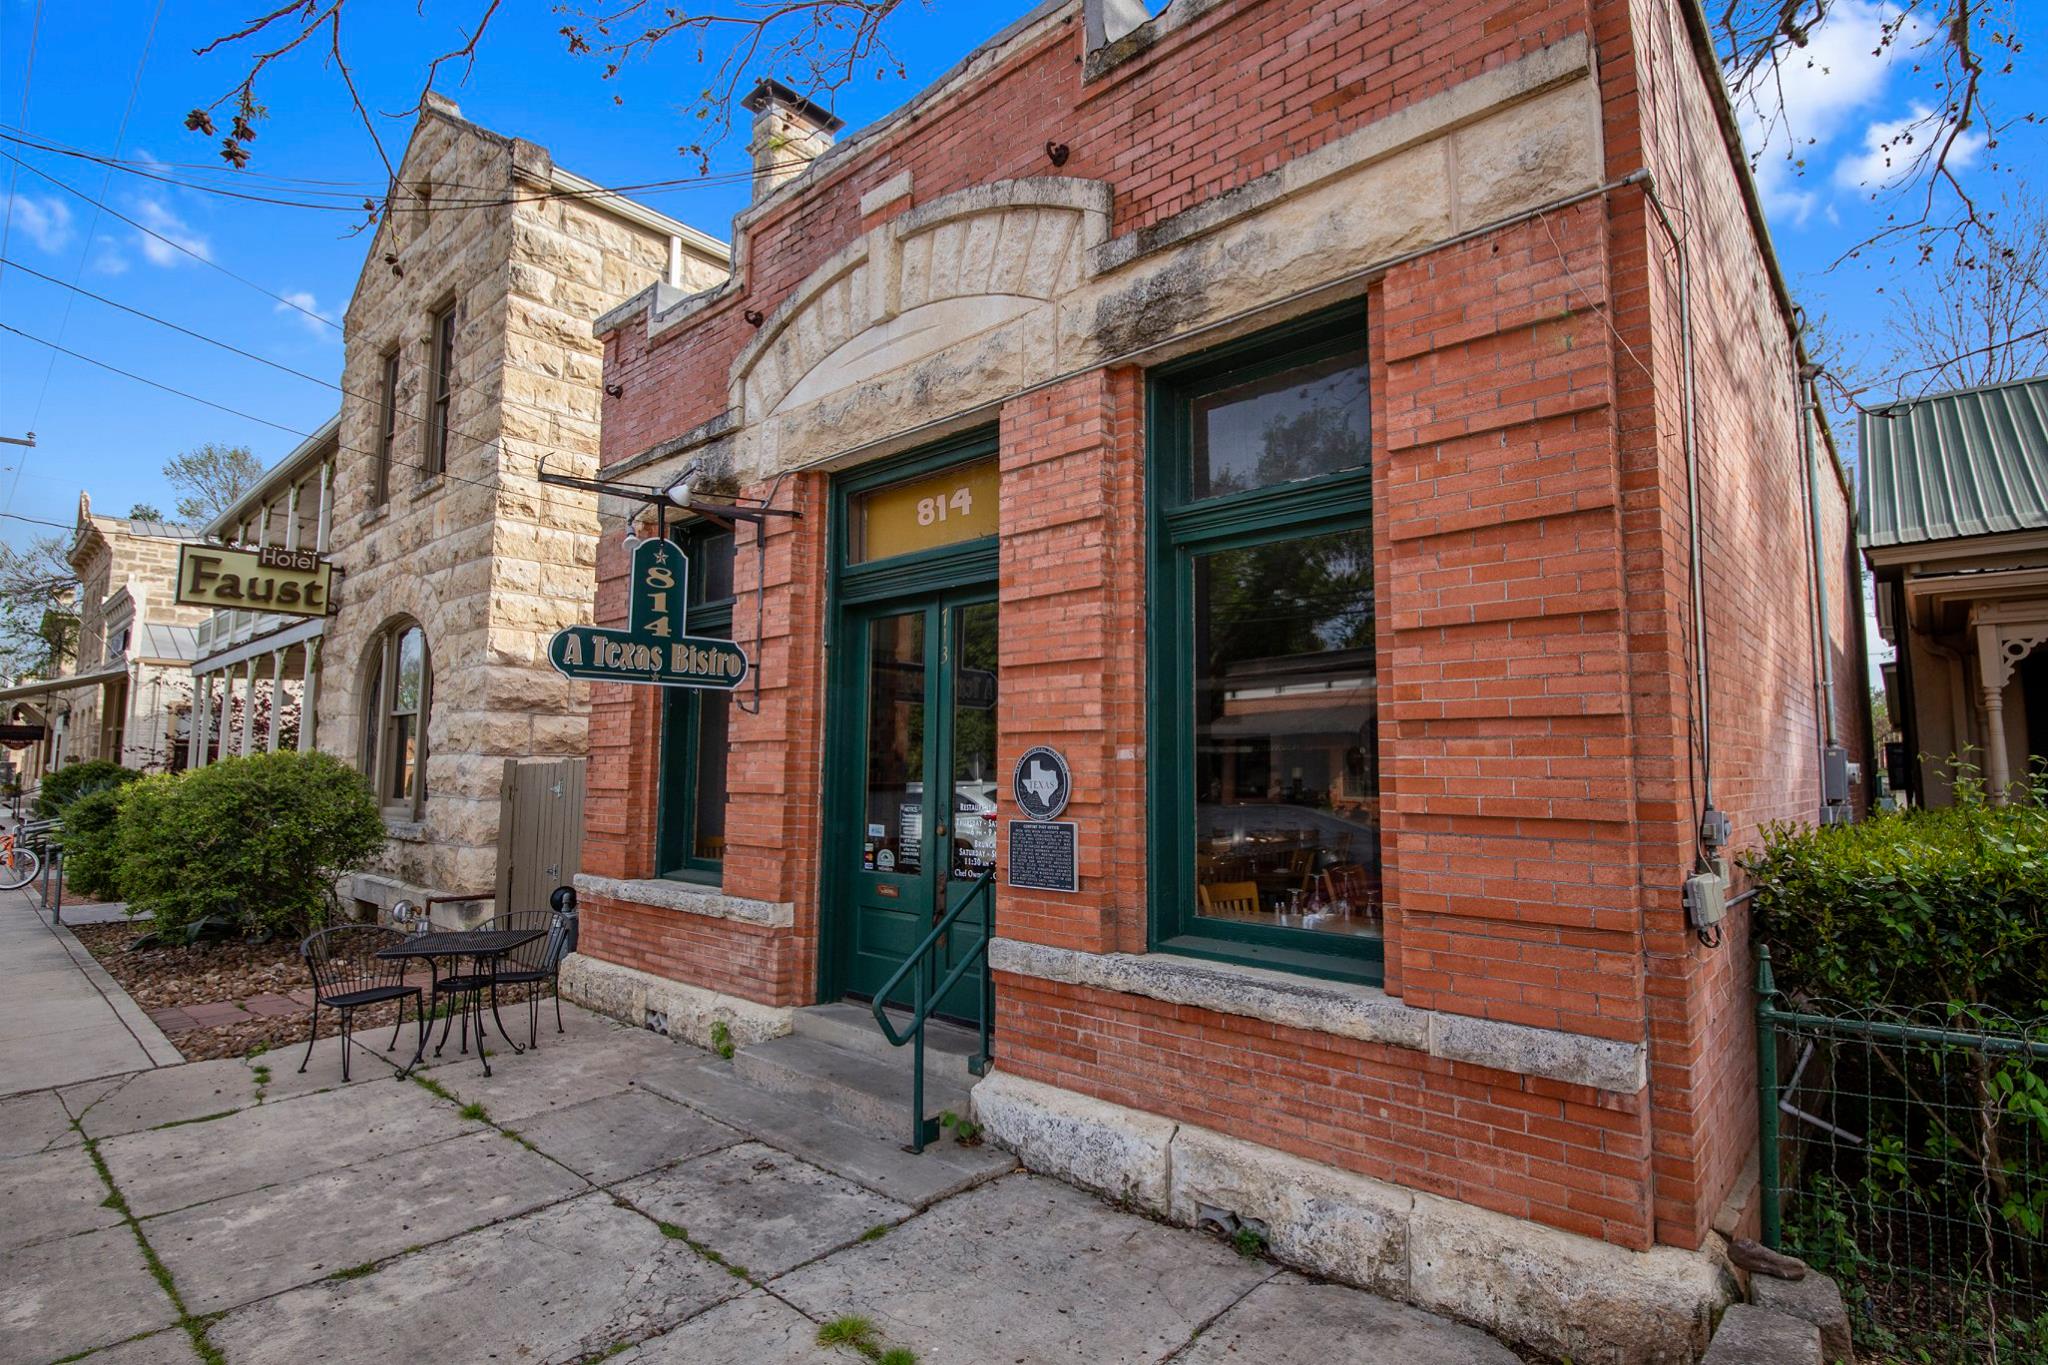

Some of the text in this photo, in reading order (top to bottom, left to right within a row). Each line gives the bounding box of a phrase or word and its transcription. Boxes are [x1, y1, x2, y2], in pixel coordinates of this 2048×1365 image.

[917, 487, 972, 526] 814
[261, 549, 317, 570] Hotel
[188, 554, 323, 607] Faust
[563, 633, 742, 678] A Texas Bistro
[1029, 780, 1056, 790] TEXAS
[959, 848, 985, 857] SATURDAY
[964, 857, 981, 867] 11:30
[954, 868, 967, 877] Chef
